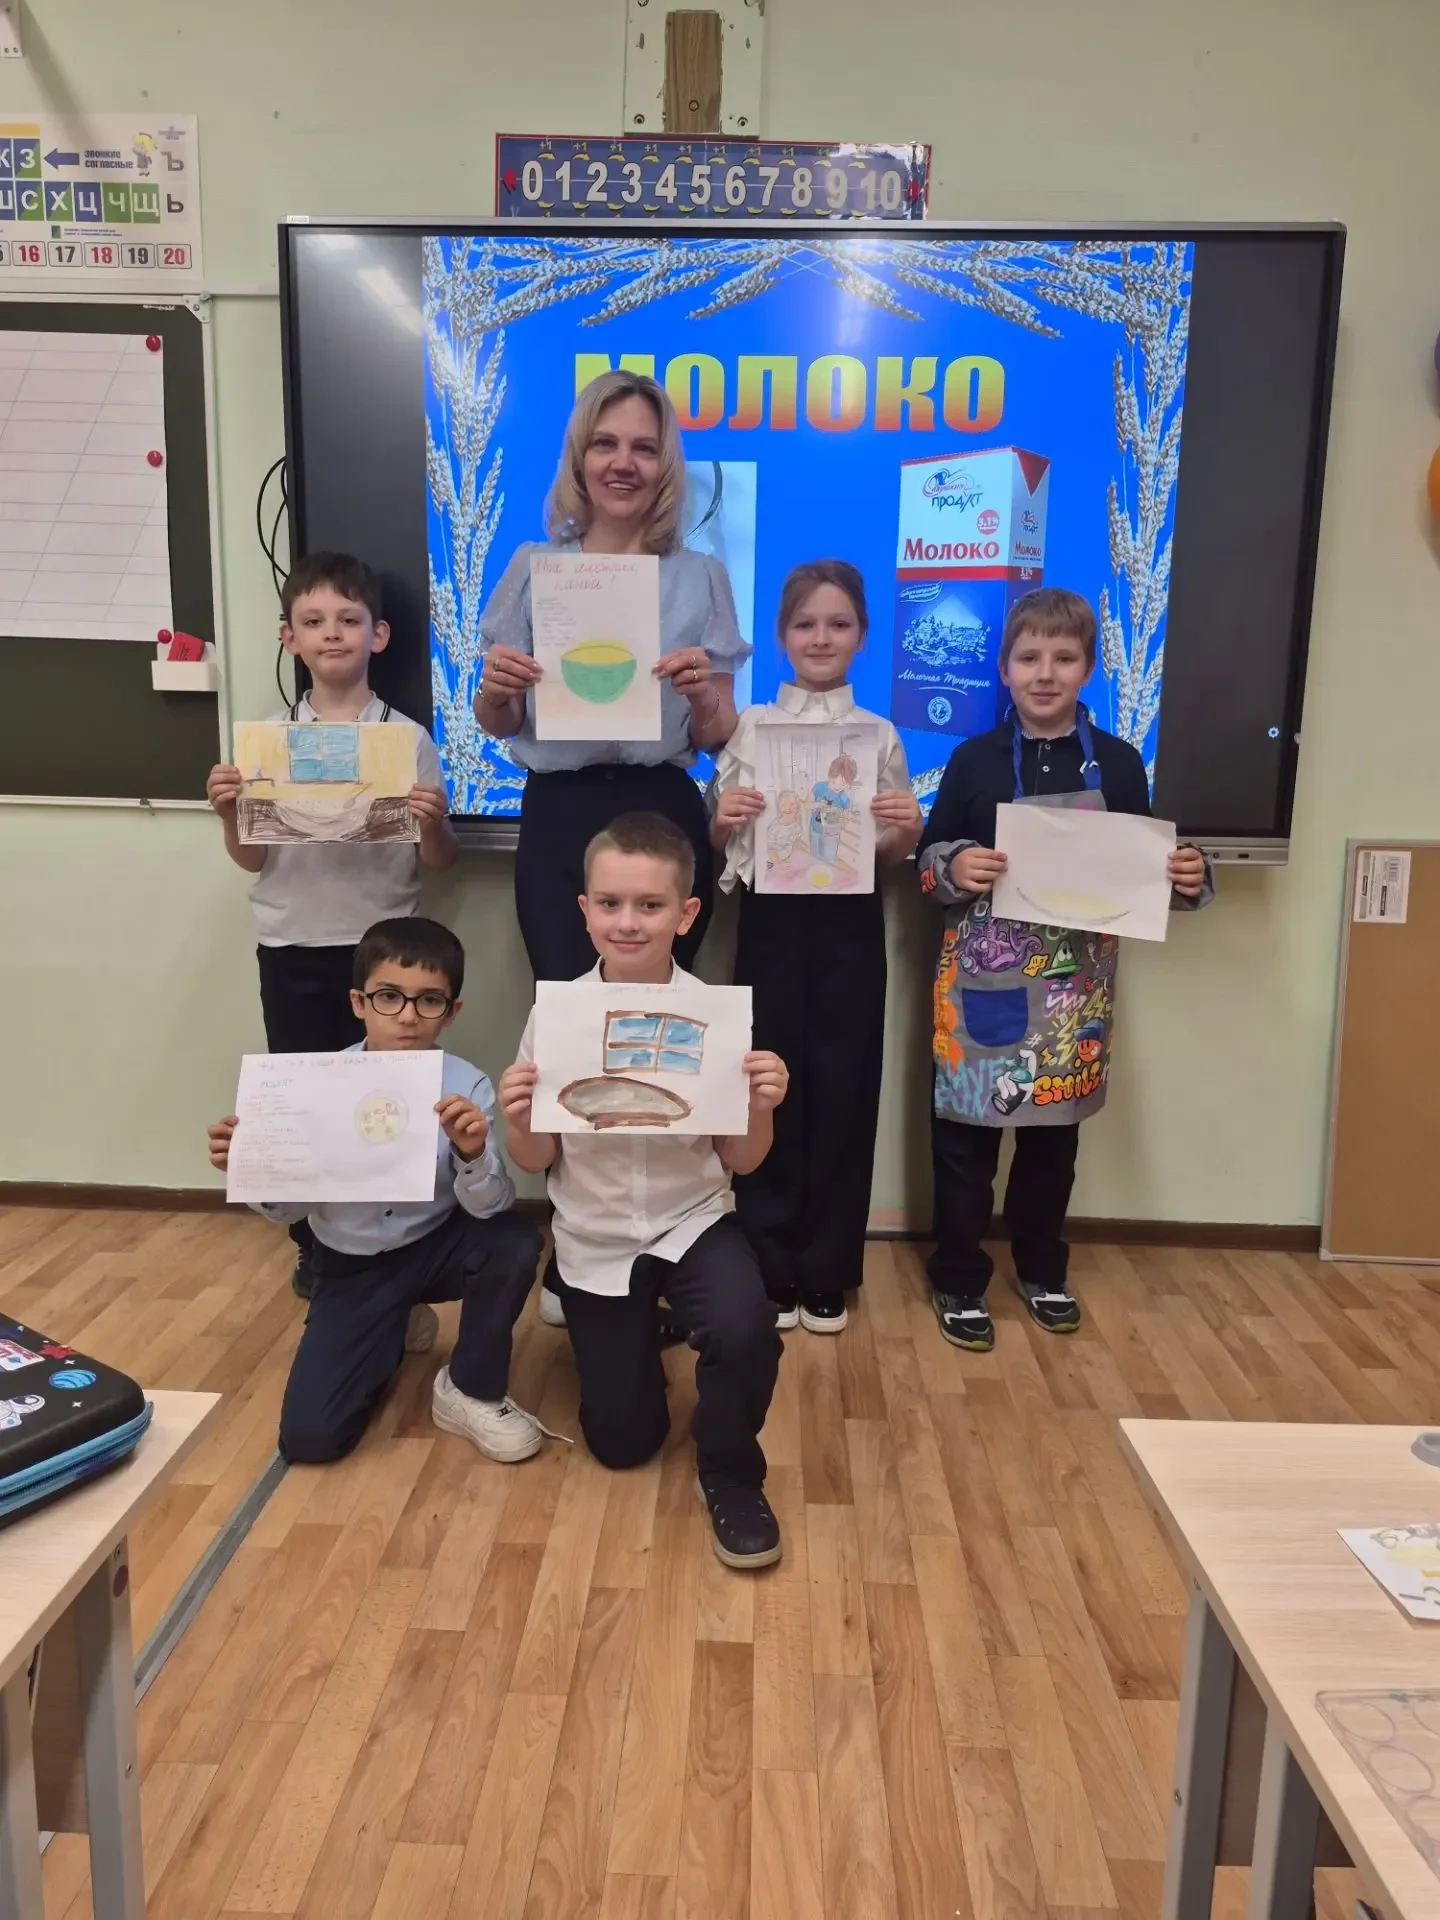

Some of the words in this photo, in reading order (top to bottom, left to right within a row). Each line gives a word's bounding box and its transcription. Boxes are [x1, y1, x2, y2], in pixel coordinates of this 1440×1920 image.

[20, 148, 36, 168] З
[85, 159, 133, 169] СОГЛАСНЫЕ
[161, 151, 185, 172] Ъ
[522, 160, 543, 201] 0
[555, 161, 571, 201] 1
[587, 162, 608, 202] 2
[621, 162, 642, 204] 3
[655, 163, 677, 204] 4
[690, 165, 711, 205] 5
[725, 165, 746, 206] 6
[759, 166, 780, 206] 7
[791, 167, 813, 208] 8
[826, 168, 848, 209] 9
[860, 170, 901, 210] 10
[21, 190, 38, 210] С
[50, 190, 68, 211] Х
[78, 191, 98, 216] Ц
[108, 191, 126, 213] Ч
[133, 192, 160, 217] Щ
[166, 193, 184, 213] Ь
[19, 244, 41, 264] 16
[55, 246, 76, 263] 17
[91, 246, 113, 265] 18
[128, 247, 149, 265] 19
[163, 247, 186, 266] 20
[903, 537, 1000, 561] Молоко
